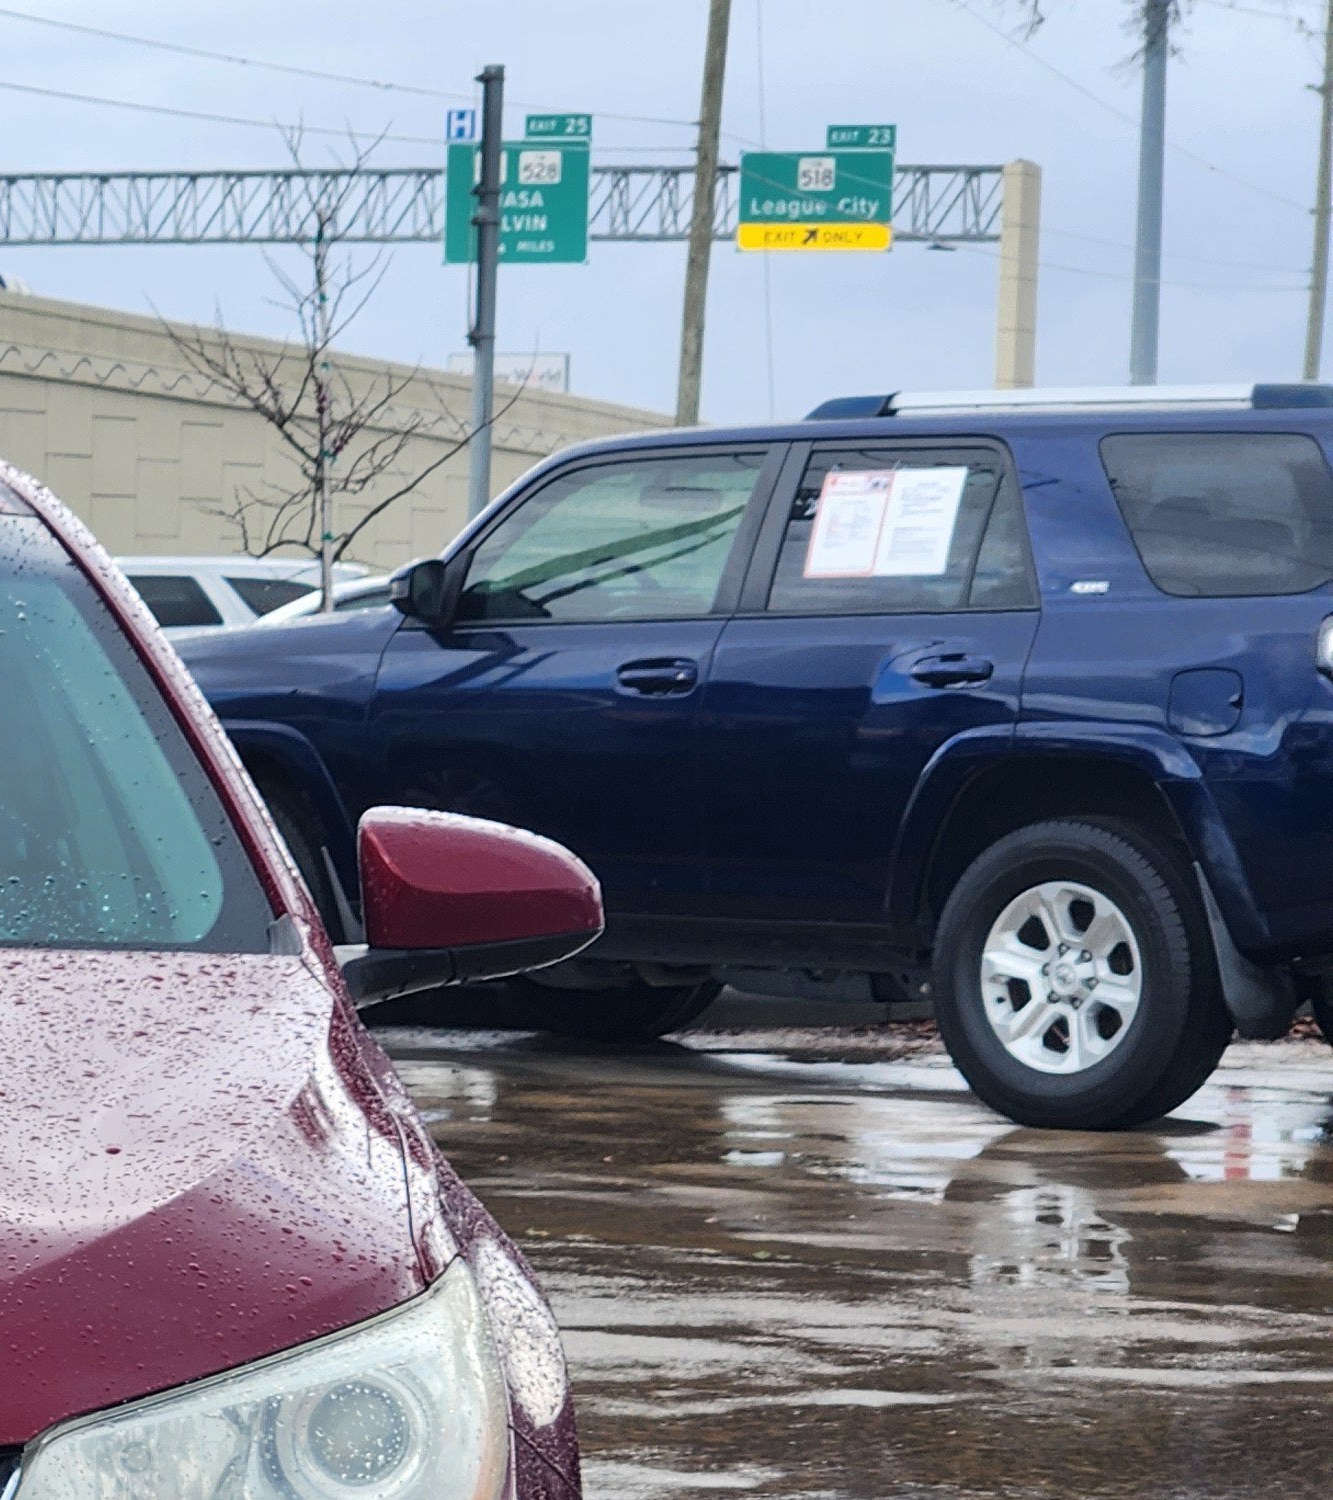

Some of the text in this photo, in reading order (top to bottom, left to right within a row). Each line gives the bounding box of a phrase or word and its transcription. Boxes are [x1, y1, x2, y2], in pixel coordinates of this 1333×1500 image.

[528, 117, 588, 133] EXIT 25
[831, 128, 892, 144] EXIT 23
[523, 162, 558, 180] 528
[800, 168, 833, 188] 518
[749, 195, 880, 220] League City
[499, 214, 548, 232] LVIN
[763, 229, 864, 244] EXIT ONLY
